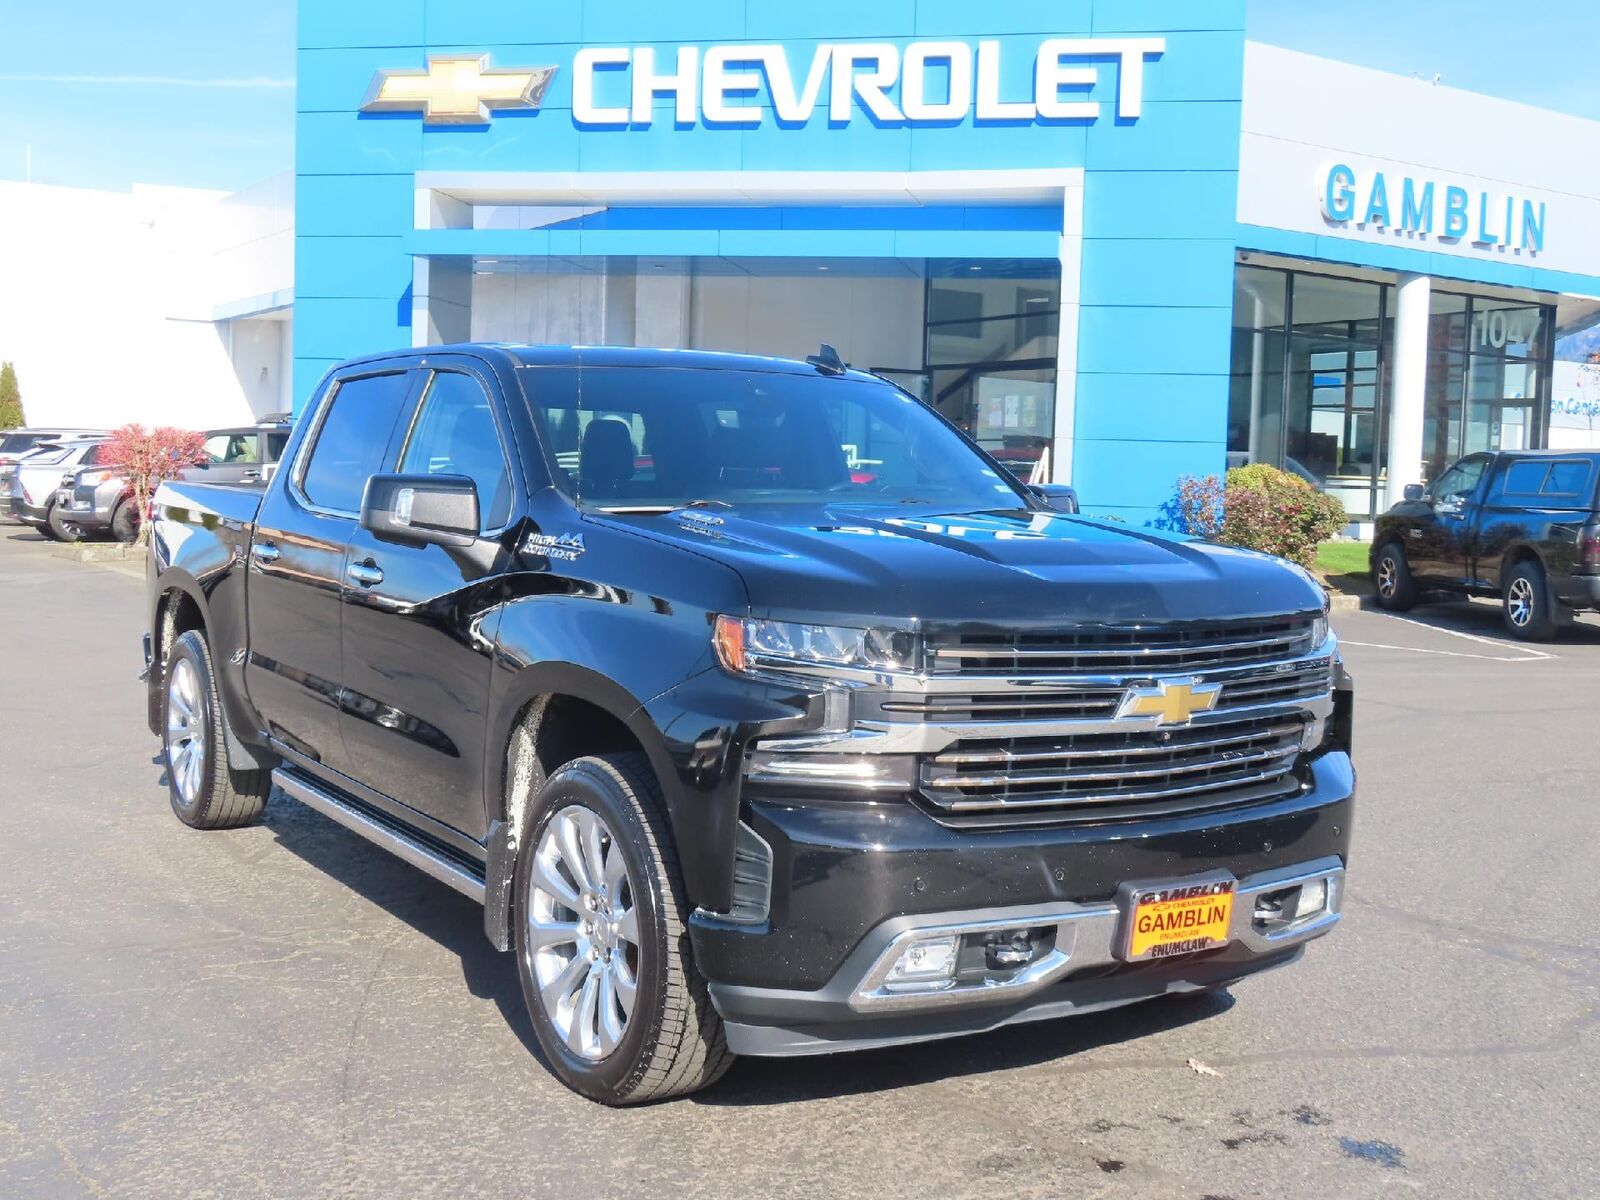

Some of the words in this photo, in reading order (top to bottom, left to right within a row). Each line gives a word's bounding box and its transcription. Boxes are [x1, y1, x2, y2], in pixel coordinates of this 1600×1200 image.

[572, 38, 1165, 124] CHEVROLET
[1325, 163, 1546, 253] GAMBLIN
[1477, 309, 1542, 352] 1047
[1566, 398, 1600, 416] Cente
[1140, 881, 1234, 905] GAMBLIN
[1173, 897, 1215, 909] CHEVROLET
[1138, 905, 1226, 933] GAMBLIN
[1152, 936, 1209, 958] ENUMCLAW
[1160, 929, 1201, 941] ENUMCLAW
